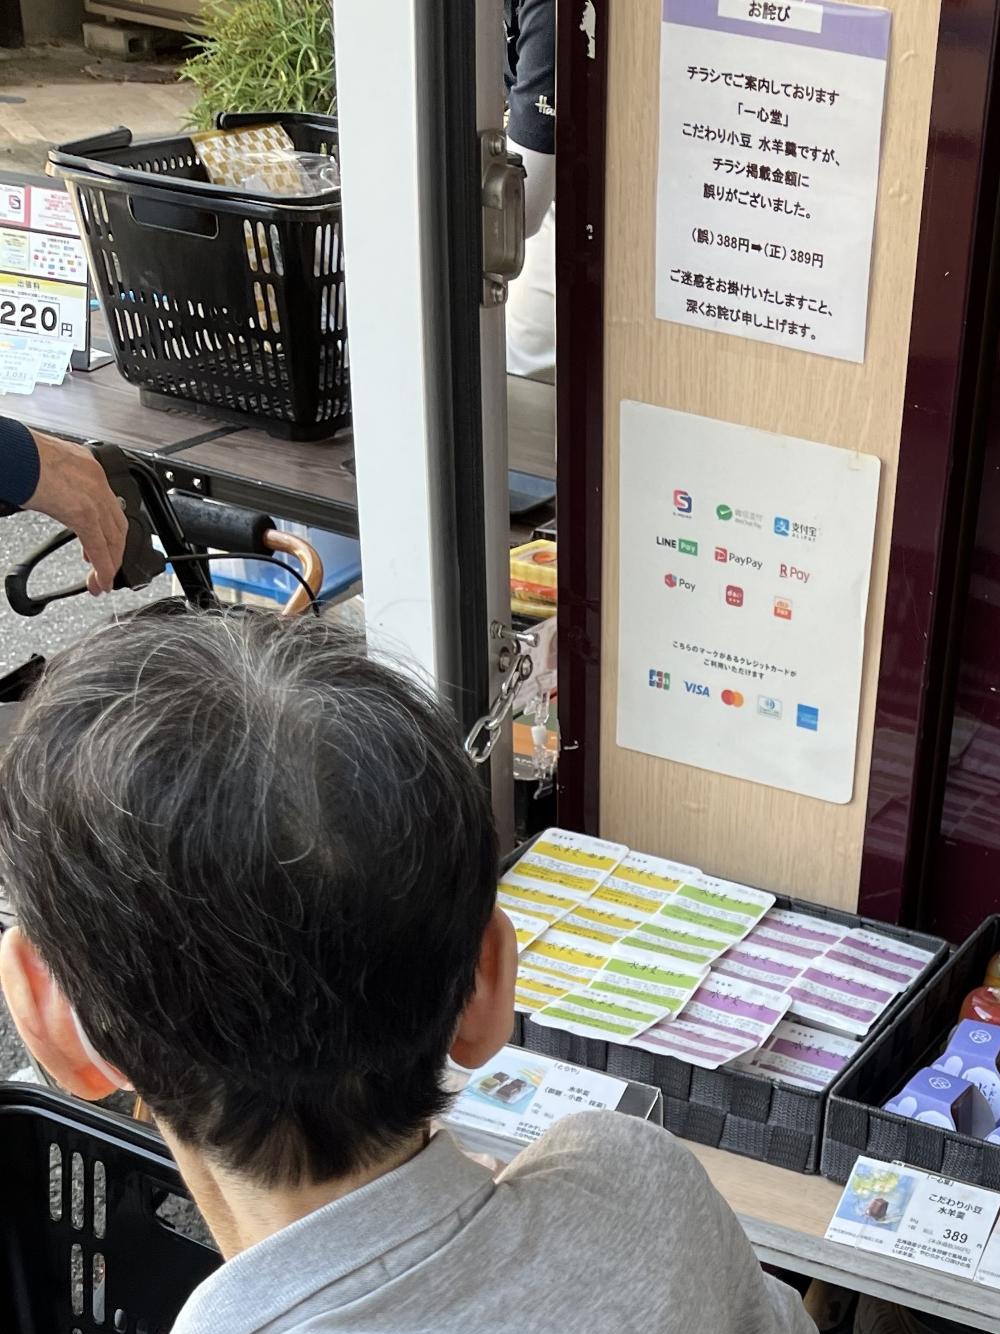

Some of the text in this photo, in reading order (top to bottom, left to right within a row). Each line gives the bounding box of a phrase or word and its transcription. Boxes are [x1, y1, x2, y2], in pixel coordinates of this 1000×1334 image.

[748, 1, 790, 21] お詫び
[687, 66, 840, 105] チラシでご案内しております
[736, 101, 790, 127] 「一心堂」
[682, 123, 753, 149] こだわり小豆
[713, 158, 810, 188] チラシ掲載金額に
[703, 183, 812, 219] 誤りがございました。
[669, 268, 833, 316] ご迷惑をお掛けいたしますこと、
[0, 301, 73, 337] 220 円
[686, 299, 816, 340] 深くお詫び申し上げます。
[656, 536, 696, 554] LINE Pay
[729, 553, 763, 570] PayPay
[679, 579, 696, 592] Pay
[790, 566, 810, 583] Pay
[672, 641, 797, 678] こちらのマークがあるクレジットカードが
[703, 659, 765, 680] ご利用いただけます
[684, 681, 710, 697] VISA
[928, 1193, 983, 1215] こだわり小豆
[937, 1206, 966, 1220] 水羊羹
[943, 1228, 969, 1244] 389
